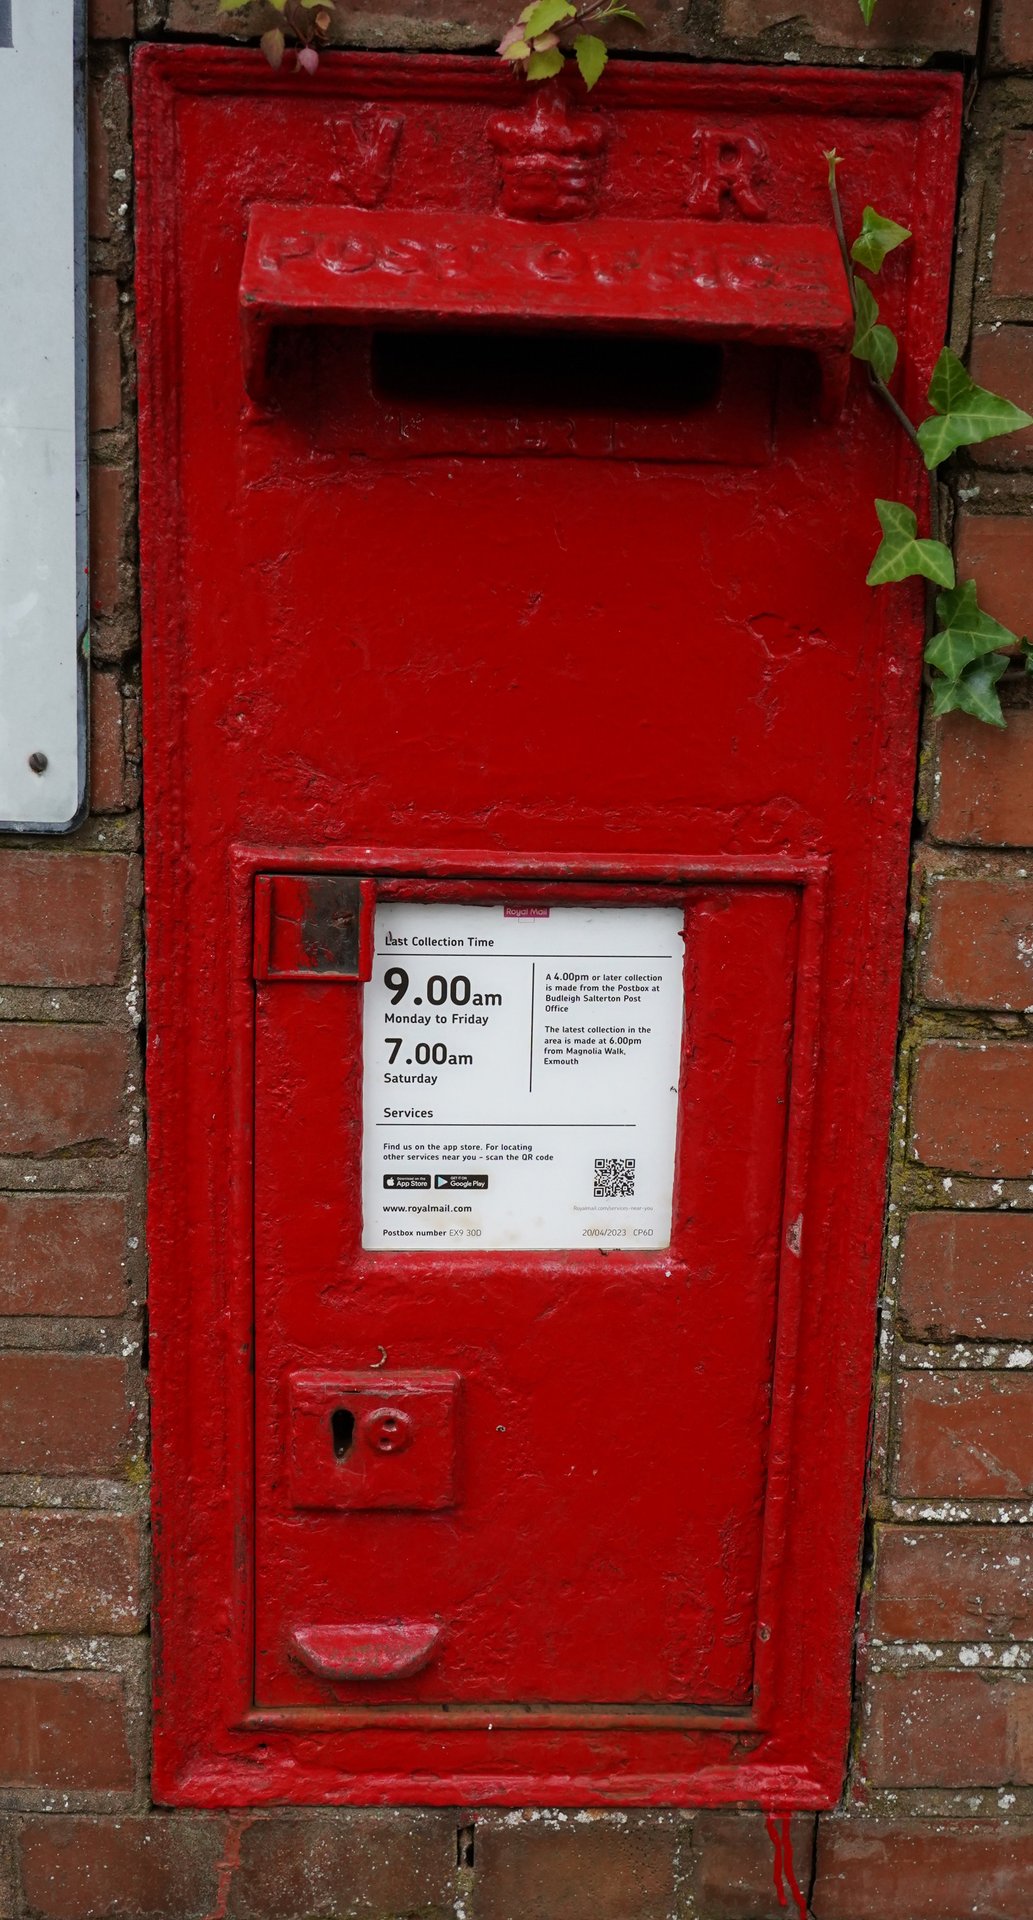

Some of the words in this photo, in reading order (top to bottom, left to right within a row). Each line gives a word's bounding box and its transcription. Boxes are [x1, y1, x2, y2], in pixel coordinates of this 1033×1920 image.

[326, 116, 402, 207] V
[695, 131, 769, 220] R
[258, 232, 485, 279] POST
[506, 908, 528, 916] Royal
[385, 936, 408, 946] Last
[412, 936, 464, 947] Collection
[467, 937, 494, 947] Time
[554, 973, 589, 983] 4.00pm
[384, 967, 502, 1006] 9.00am
[545, 995, 580, 1003] Budleigh
[384, 1013, 431, 1025] Monday
[436, 1014, 447, 1024] to
[452, 1014, 488, 1026] Friday
[609, 1037, 642, 1046] 6.00pm
[384, 1038, 473, 1065] 7.00am
[566, 1048, 601, 1056] Magnolia
[384, 1073, 438, 1085] Saturday
[384, 1107, 433, 1118] Services
[501, 1144, 532, 1152] locating
[383, 1205, 472, 1214] www.royalmail.com
